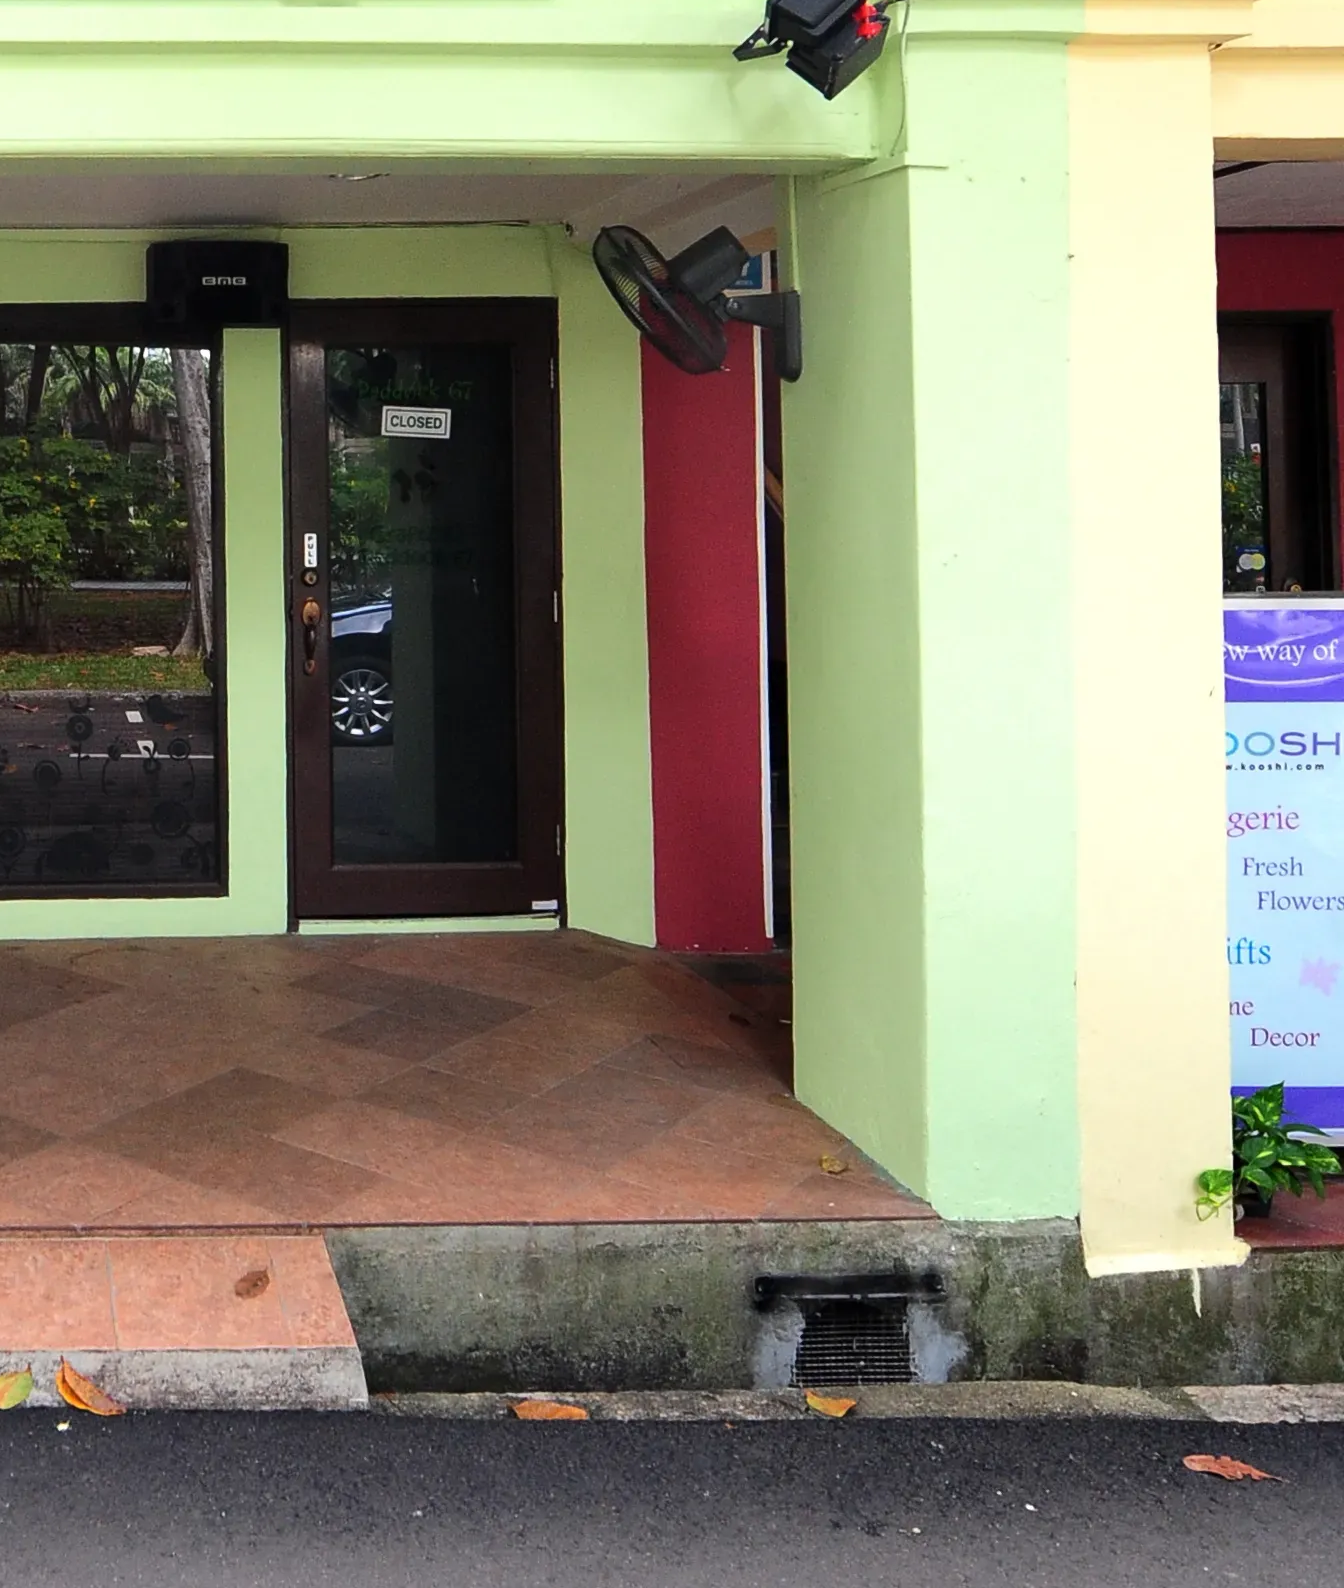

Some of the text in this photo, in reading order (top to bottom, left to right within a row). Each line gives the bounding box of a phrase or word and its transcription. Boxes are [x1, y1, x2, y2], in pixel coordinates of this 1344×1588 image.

[390, 414, 443, 430] CLOSED
[307, 535, 315, 565] PULL
[1257, 644, 1306, 667] way
[1312, 638, 1339, 661] of
[1226, 804, 1301, 838] gerie
[1242, 856, 1304, 877] Fresh
[1256, 890, 1344, 911] Flowers
[1226, 936, 1272, 965] ifts
[1250, 1027, 1321, 1047] Decor
